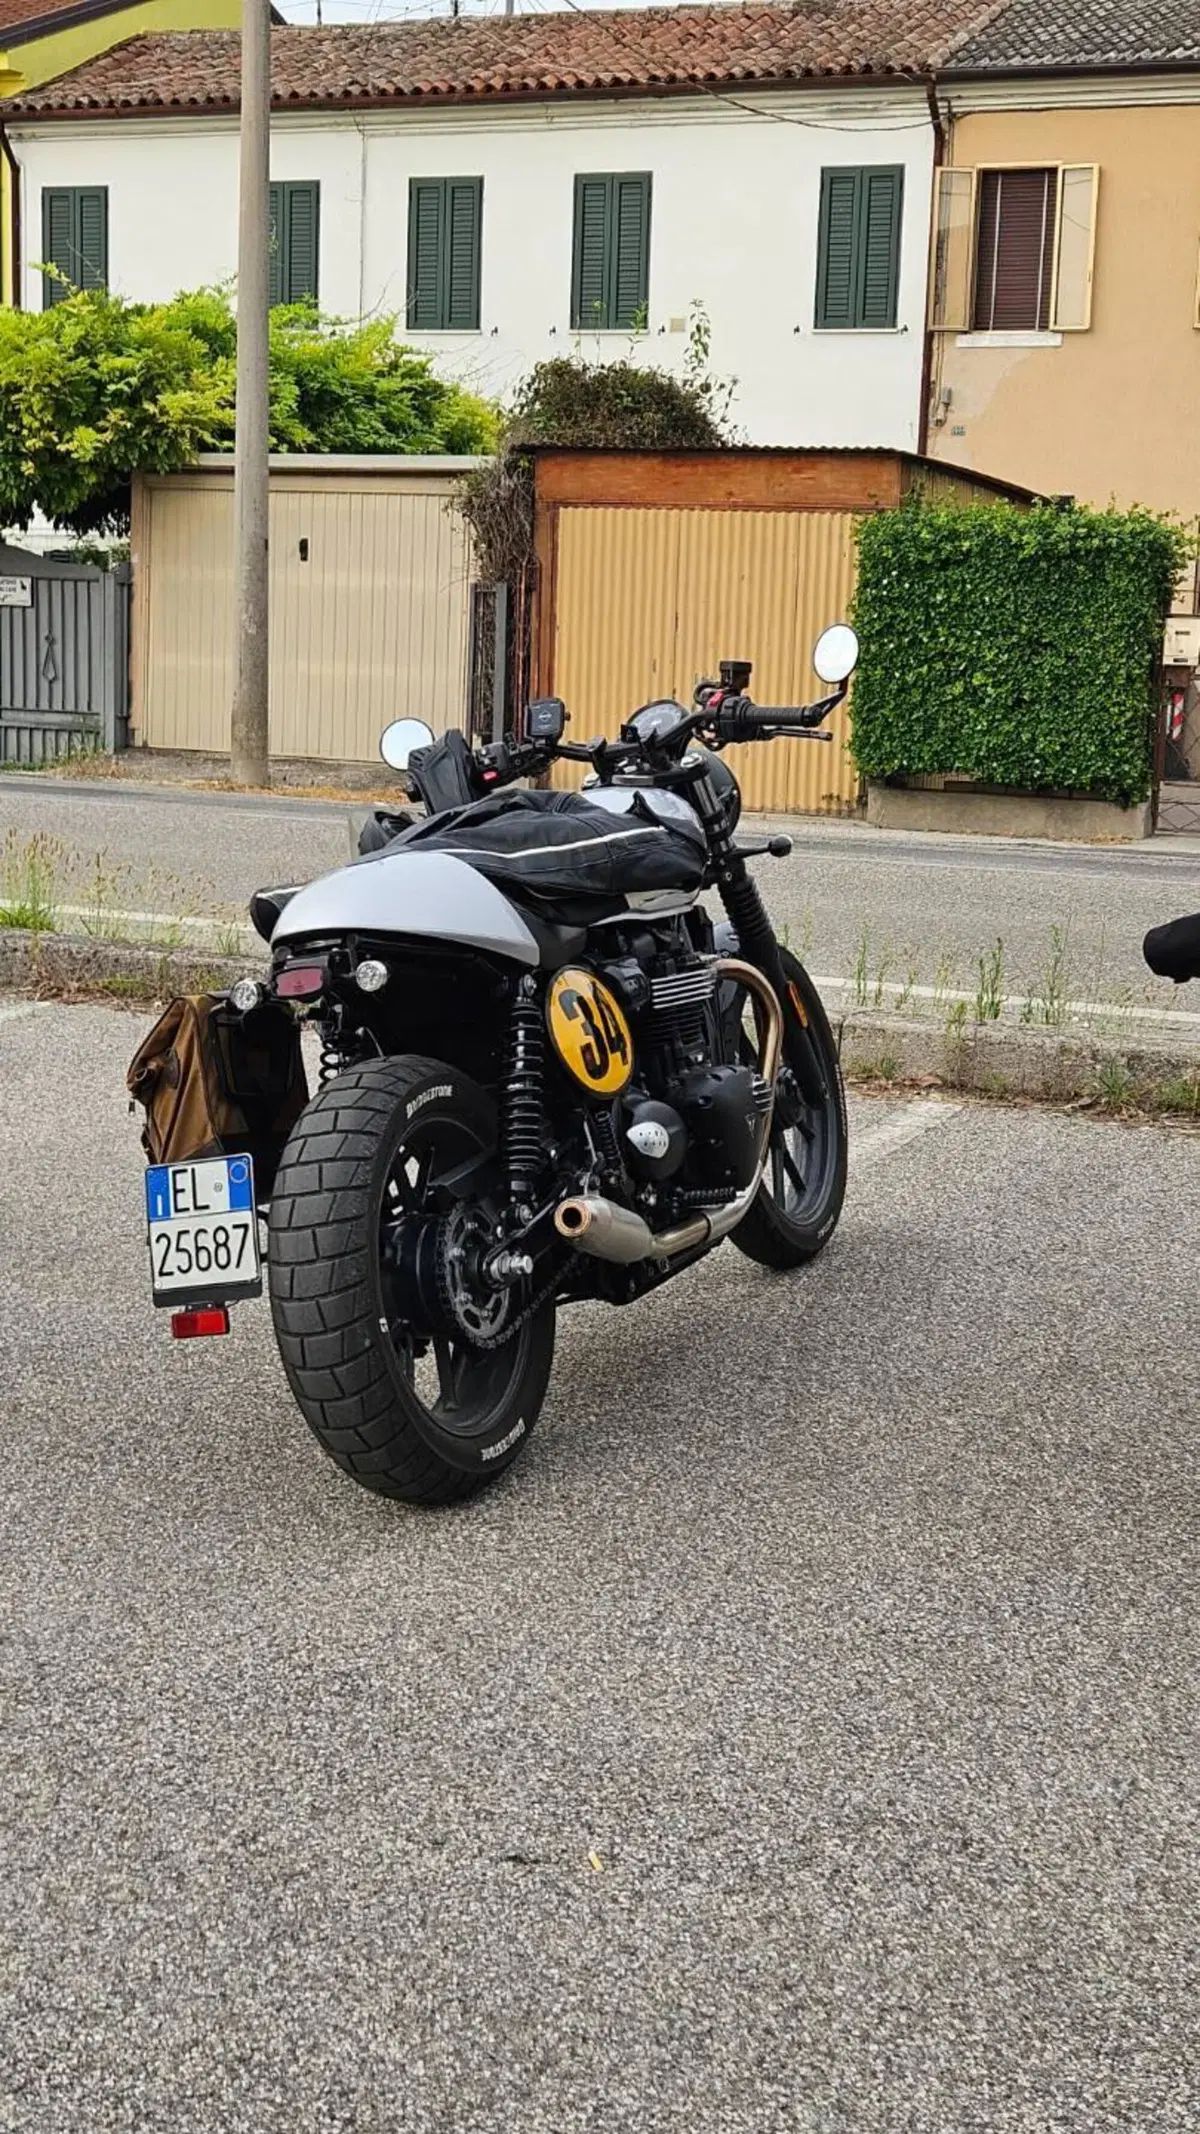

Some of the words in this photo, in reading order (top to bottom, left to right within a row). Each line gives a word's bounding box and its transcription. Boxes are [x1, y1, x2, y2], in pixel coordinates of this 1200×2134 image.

[558, 981, 628, 1080] 34
[172, 1168, 210, 1213] EL
[155, 1223, 250, 1278] 25687
